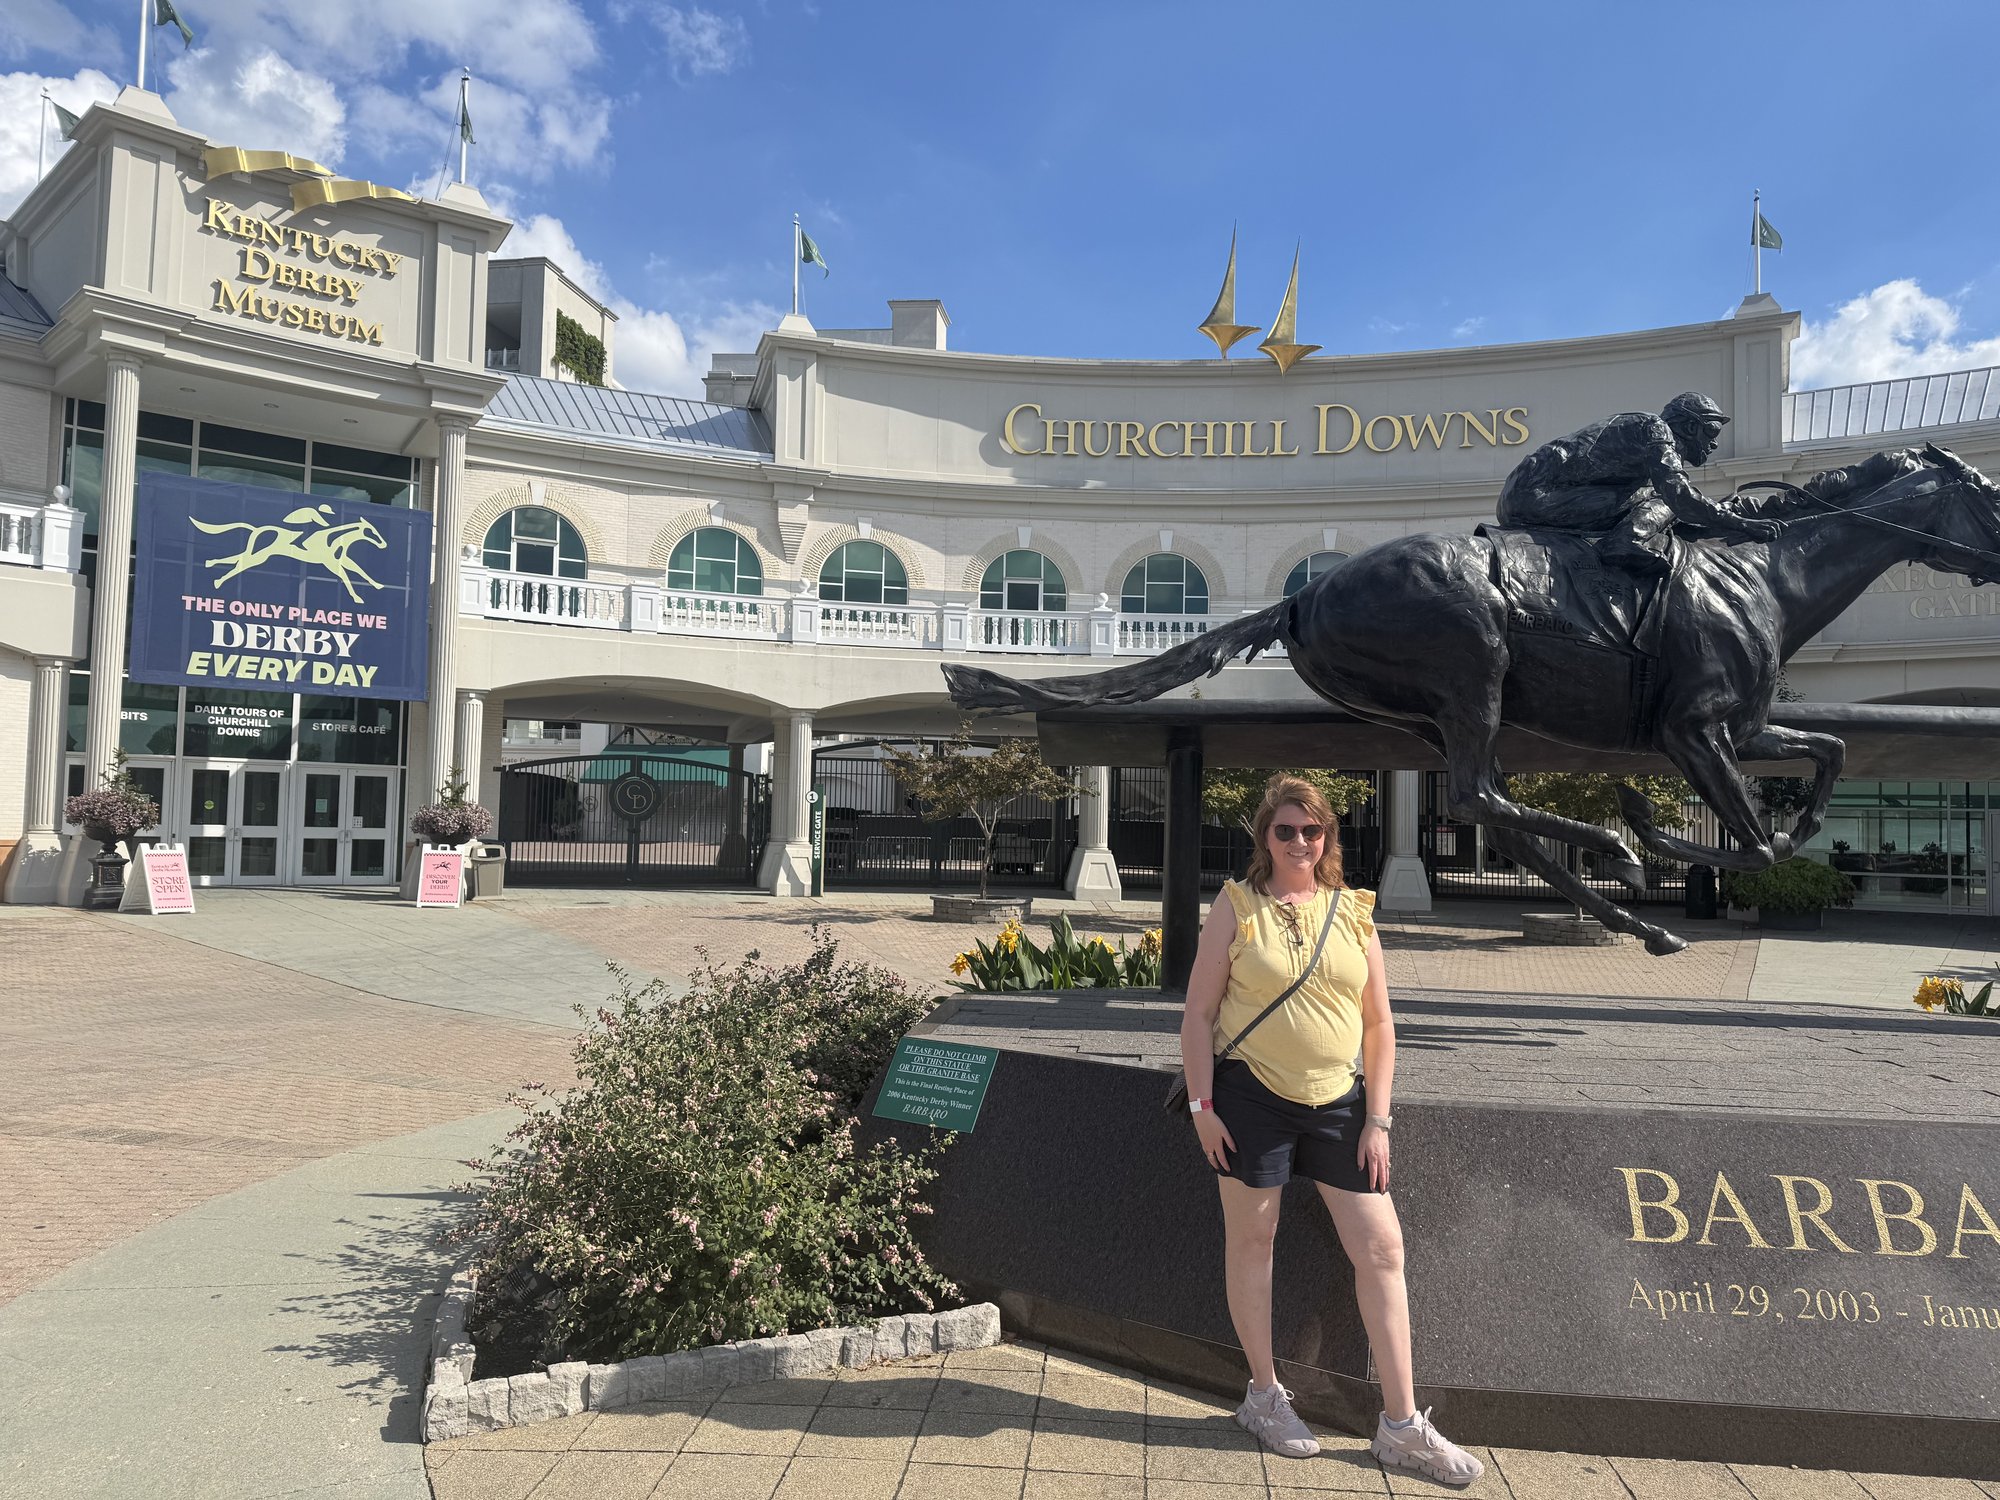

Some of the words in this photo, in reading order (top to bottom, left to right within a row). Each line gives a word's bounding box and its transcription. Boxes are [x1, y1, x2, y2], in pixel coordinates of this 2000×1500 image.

[204, 197, 403, 275] KENTUCKY
[241, 245, 365, 303] DERBY
[215, 277, 384, 344] MUSEUM
[1003, 403, 1299, 458] CHURCHILL
[1313, 403, 1531, 455] DOWNS
[182, 595, 225, 614] THE
[229, 601, 284, 620] ONLY
[288, 607, 352, 626] PLACE
[357, 614, 387, 629] WE
[210, 620, 360, 658] DERBY
[186, 651, 307, 683] EVERY
[312, 661, 378, 688] DAY
[194, 704, 228, 715] DAILY
[229, 706, 267, 718] TOURS
[269, 709, 285, 719] OF
[207, 716, 271, 728] CHURCHILL
[312, 722, 348, 732] STORE
[349, 724, 357, 733] &
[359, 724, 386, 734] CAFÉ
[217, 727, 261, 737] DOWNS
[814, 830, 822, 859] SERVICE
[152, 876, 185, 885] STORE
[155, 885, 185, 893] OPEN!
[905, 1045, 932, 1055] PLEASE
[934, 1049, 945, 1057] DO
[946, 1050, 961, 1059] NOT
[961, 1051, 987, 1062] CLIMB
[913, 1055, 925, 1063] ON
[926, 1057, 943, 1066] THIS
[942, 1059, 971, 1070] STATUE
[899, 1063, 912, 1071] OR
[912, 1065, 926, 1073] THE
[926, 1067, 961, 1079] GRANITE
[961, 1072, 981, 1082] BASE
[895, 1077, 906, 1086] This
[920, 1081, 934, 1090] Final
[933, 1083, 953, 1093] Resting
[953, 1086, 967, 1095] Place
[886, 1090, 901, 1099] 2006
[901, 1091, 929, 1105] Kentucky
[930, 1096, 949, 1108] Derby
[950, 1098, 973, 1110] Winner
[902, 1103, 948, 1120] BARBARO
[1613, 1166, 2000, 1260] BARBA
[1628, 1277, 1717, 1321] April
[1727, 1283, 1784, 1324] 29,
[1792, 1287, 1881, 1324] 2003
[1917, 1294, 2000, 1330] Janu
